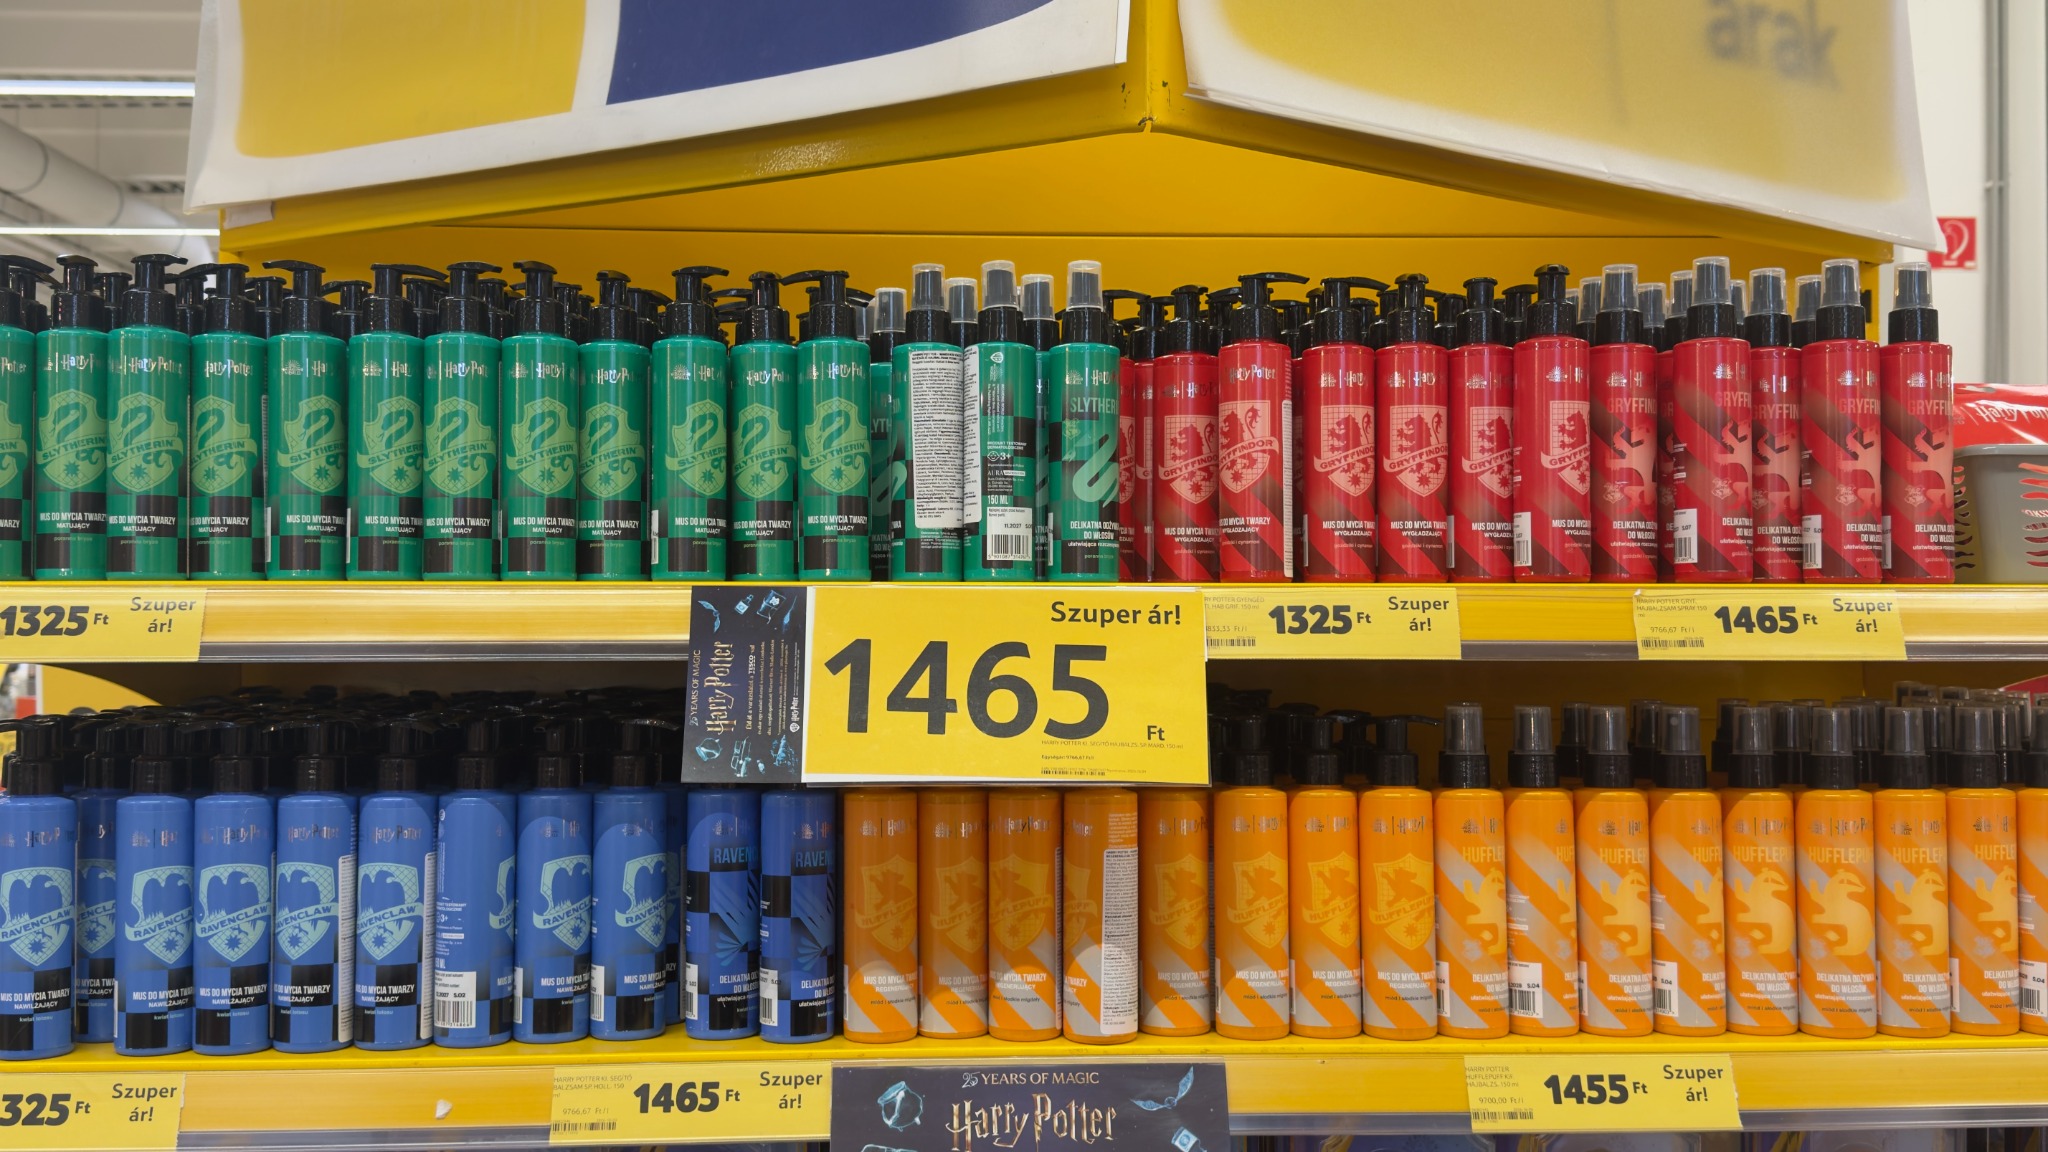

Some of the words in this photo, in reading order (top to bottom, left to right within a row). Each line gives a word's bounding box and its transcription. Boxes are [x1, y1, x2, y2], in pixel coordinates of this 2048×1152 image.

[129, 358, 156, 373] Harry
[445, 362, 470, 378] Harry
[1251, 365, 1276, 383] Potter
[1752, 403, 1799, 420] GRYFFIN
[1975, 405, 2017, 422] Harry
[111, 440, 176, 463] SLYTHERIN
[428, 443, 488, 468] SLYTHERIN
[516, 444, 574, 466] SLYTHERIN
[1000, 452, 1011, 460] 3+
[1220, 439, 1273, 463] RYFFINDOR
[735, 447, 787, 472] SLYTHERIN
[988, 495, 998, 505] 150
[1000, 495, 1008, 504] ML
[119, 516, 126, 524] DO
[128, 516, 148, 525] MYCIA
[150, 516, 175, 525] TWARZY
[436, 518, 443, 526] DO
[444, 518, 465, 526] MYCIA
[467, 518, 490, 527] TWARZY
[1226, 518, 1245, 526] MYCIA
[1246, 517, 1270, 525] TWARZY
[1391, 521, 1403, 529] MUS
[1404, 521, 1412, 529] DO
[1414, 521, 1431, 529] MYCIA
[1613, 521, 1645, 529] DELIKATNA
[1084, 531, 1092, 539] DO
[130, 597, 196, 613] Szuper
[1388, 596, 1449, 613] Szuper
[1833, 598, 1893, 615] Szuper
[0, 605, 89, 636] 1325
[94, 613, 109, 625] Ft
[1051, 601, 1141, 628] Szuper
[1148, 605, 1181, 625] ár!
[1269, 605, 1352, 634] 1325
[1357, 612, 1371, 623] Ft
[1714, 606, 1798, 634] 1465
[1803, 613, 1818, 625] Ft
[148, 619, 172, 633] ár!
[1409, 618, 1432, 632] ár!
[1650, 626, 1677, 634] 9766,67
[1856, 619, 1878, 633] ár!
[692, 650, 701, 676] MAGIC
[703, 641, 737, 688] Potter
[748, 655, 756, 674] TESCO
[692, 678, 699, 689] OF
[824, 638, 1109, 740] 1465
[1147, 725, 1165, 741] Ft
[690, 690, 699, 715] YEARS
[704, 689, 737, 735] Harry
[713, 848, 751, 864] RAVEN
[1600, 847, 1646, 864] HUFFLE
[1975, 845, 2015, 860] HUFFLE
[1, 908, 71, 939] RAVENCLAW
[200, 905, 268, 935] RAVENCLAW
[541, 978, 555, 986] MUS
[557, 977, 565, 986] DO
[567, 976, 581, 986] MYCIA
[1004, 973, 1021, 982] MYCIA
[1023, 973, 1046, 982] TWARZY
[1378, 971, 1390, 980] MUS
[1392, 971, 1400, 980] DO
[1401, 971, 1420, 980] MYCIA
[1817, 973, 1851, 982] DELIKATNA
[1, 993, 13, 1001] MUS
[14, 992, 23, 1001] DO
[24, 992, 46, 1000] MYCIA
[48, 988, 70, 999] TWARZY
[1832, 984, 1839, 993] DO
[1842, 984, 1867, 994] WŁOSÓW
[14, 1001, 58, 1010] NAWILŻAJĄCY
[760, 1071, 822, 1088] Szuper
[962, 1071, 978, 1089] 25
[981, 1072, 1027, 1085] YEARS
[1030, 1072, 1049, 1085] OF
[1052, 1071, 1099, 1085] MAGIC
[1663, 1064, 1723, 1082] Szuper
[112, 1083, 177, 1101] Szuper
[633, 1081, 720, 1114] 1465
[726, 1089, 740, 1102] Ft
[1544, 1074, 1629, 1105] 1455
[1633, 1081, 1648, 1094] Ft
[1686, 1087, 1709, 1102] ár!
[75, 1101, 91, 1114] Ft
[779, 1094, 802, 1109] ár!
[129, 1107, 153, 1121] ár!
[563, 1107, 591, 1115] 9766,67
[945, 1099, 1029, 1152] Harry
[1033, 1093, 1116, 1152] Potter
